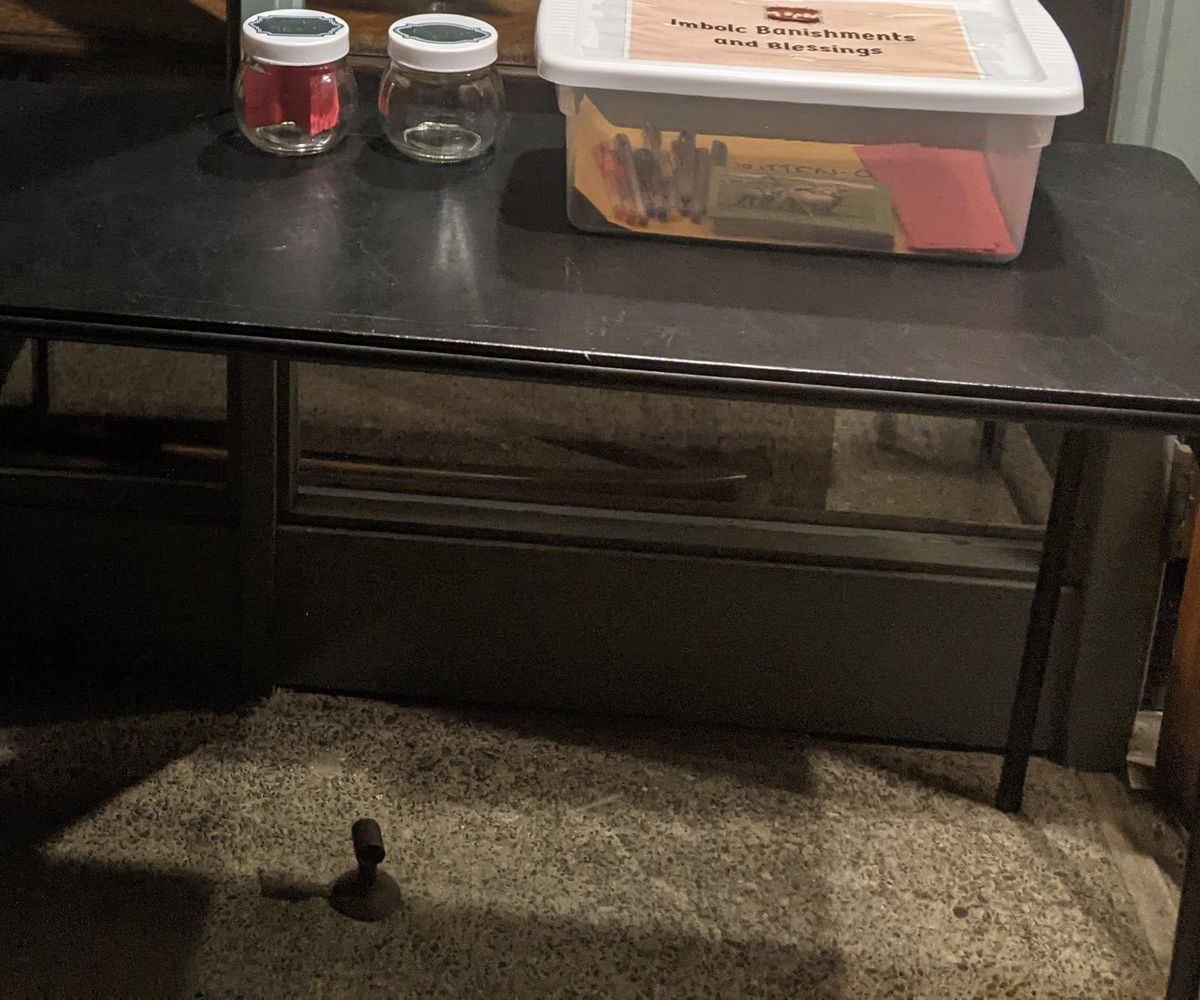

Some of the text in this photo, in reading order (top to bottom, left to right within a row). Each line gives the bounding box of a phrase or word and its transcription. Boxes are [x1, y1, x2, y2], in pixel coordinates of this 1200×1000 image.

[670, 18, 916, 42] Imbolc Banishments
[714, 36, 883, 57] and Blessings
